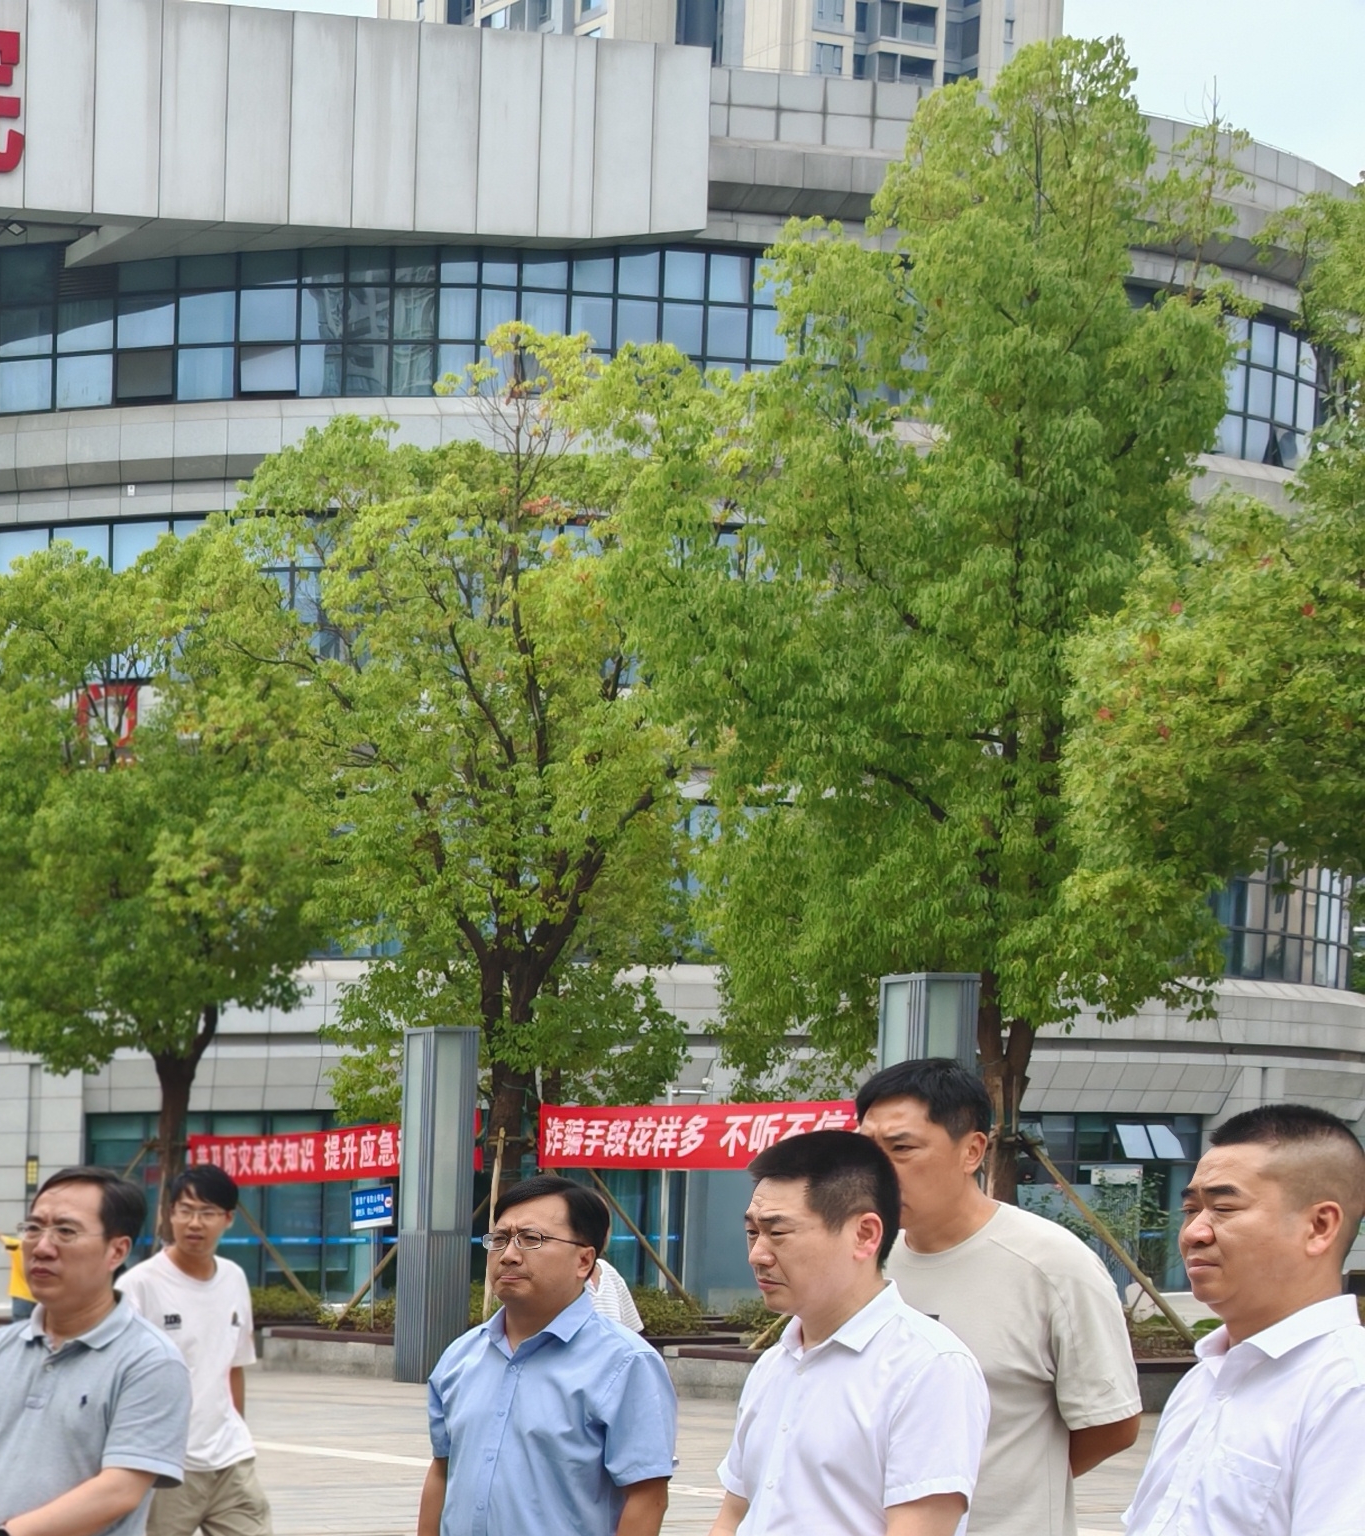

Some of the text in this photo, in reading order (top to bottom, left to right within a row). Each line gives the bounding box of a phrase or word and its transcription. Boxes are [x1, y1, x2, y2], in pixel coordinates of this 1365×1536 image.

[324, 1130, 402, 1171] 提升应急
[544, 1115, 708, 1158] 诈骗手段花样多
